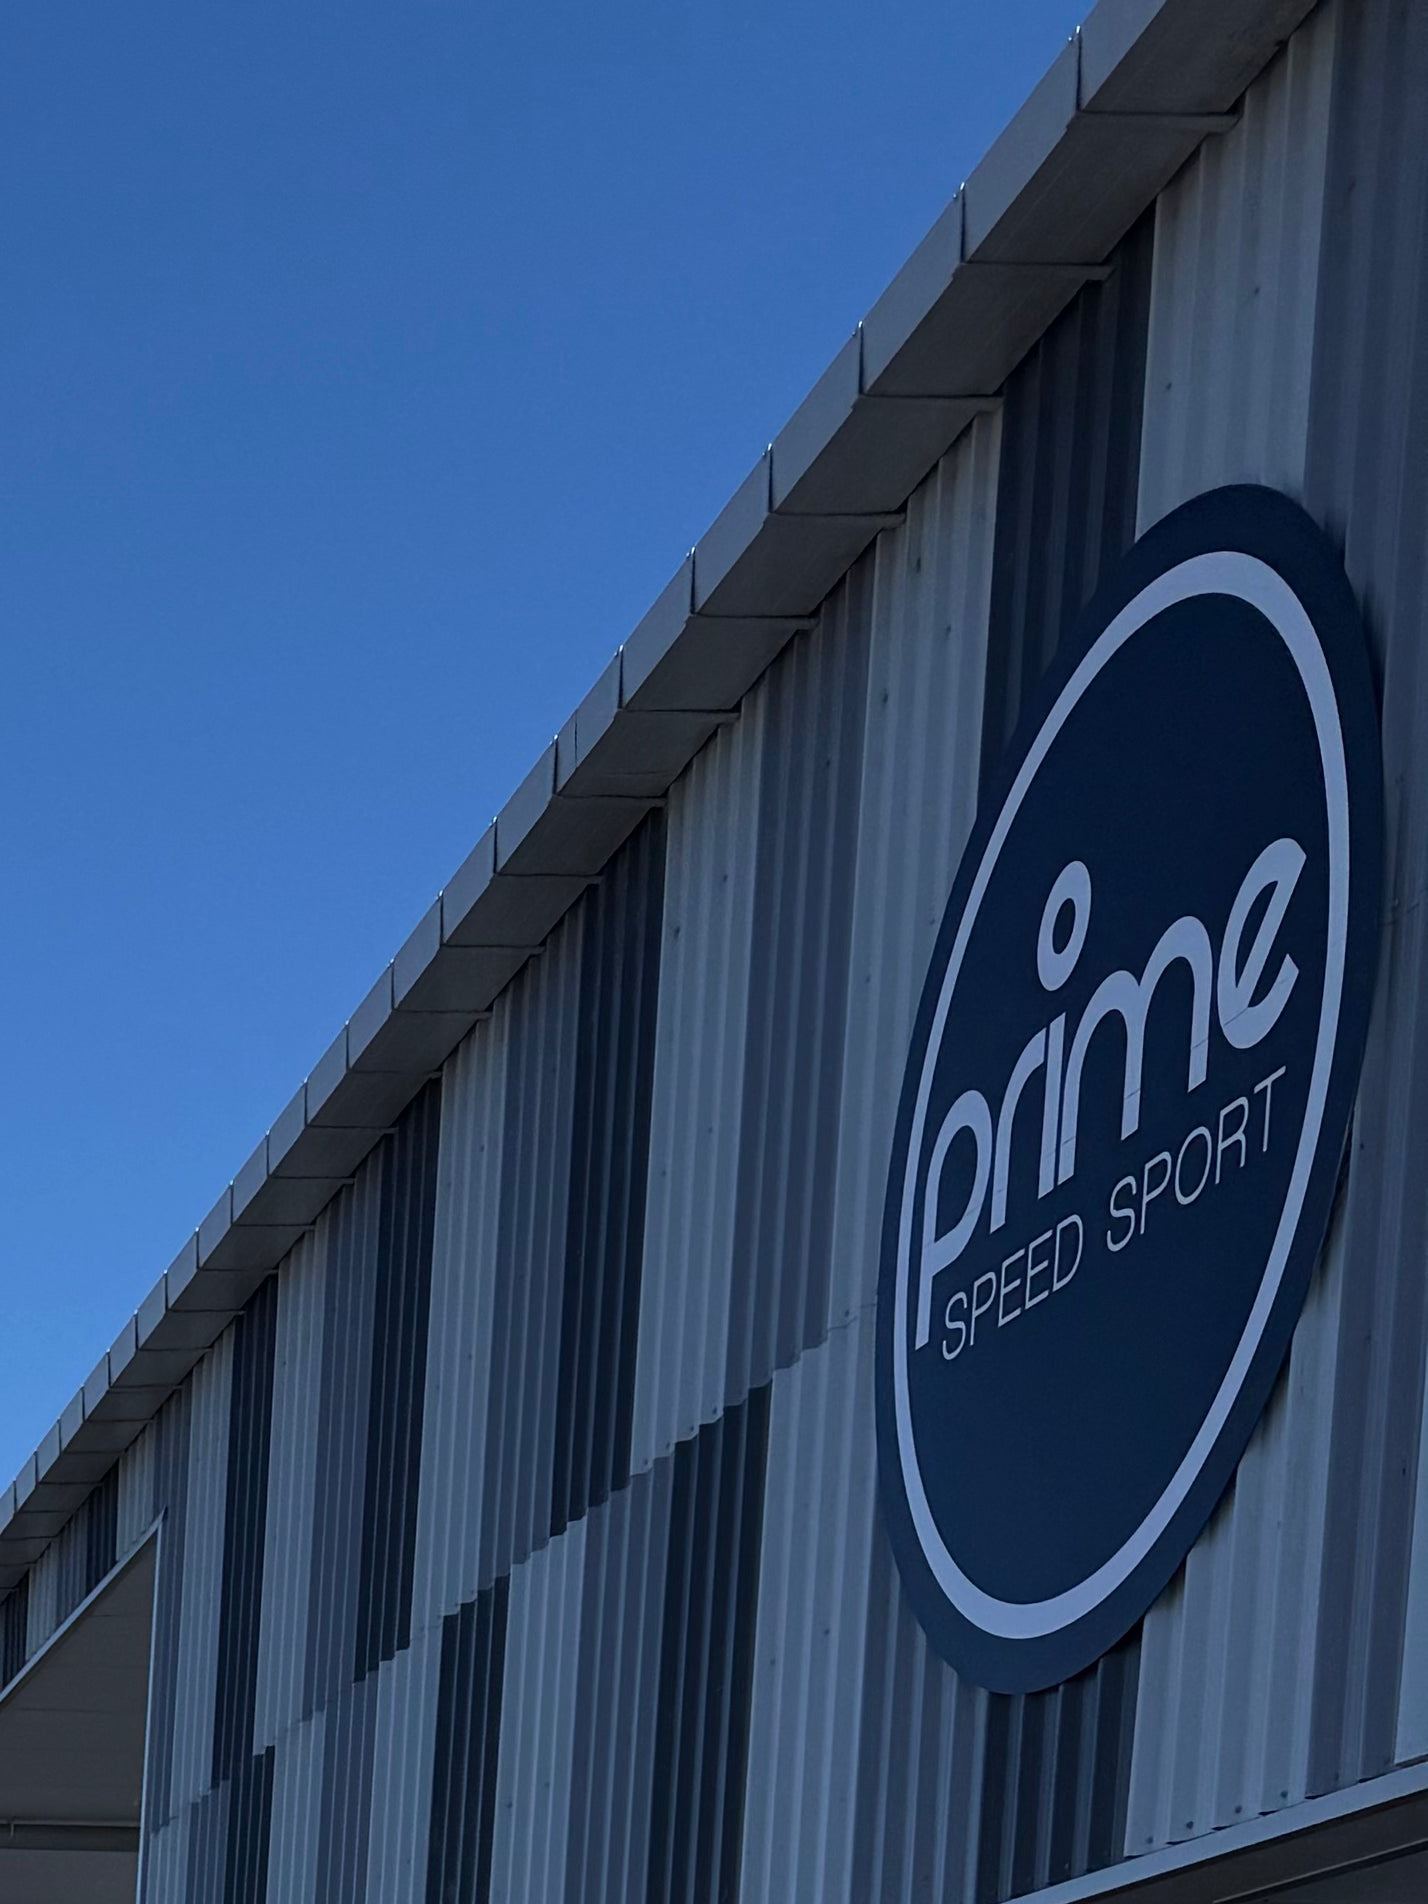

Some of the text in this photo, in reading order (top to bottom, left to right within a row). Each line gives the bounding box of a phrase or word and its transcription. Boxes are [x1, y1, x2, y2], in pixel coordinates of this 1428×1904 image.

[915, 837, 1307, 1352] prime
[941, 1065, 1287, 1361] SPEED SPORT
